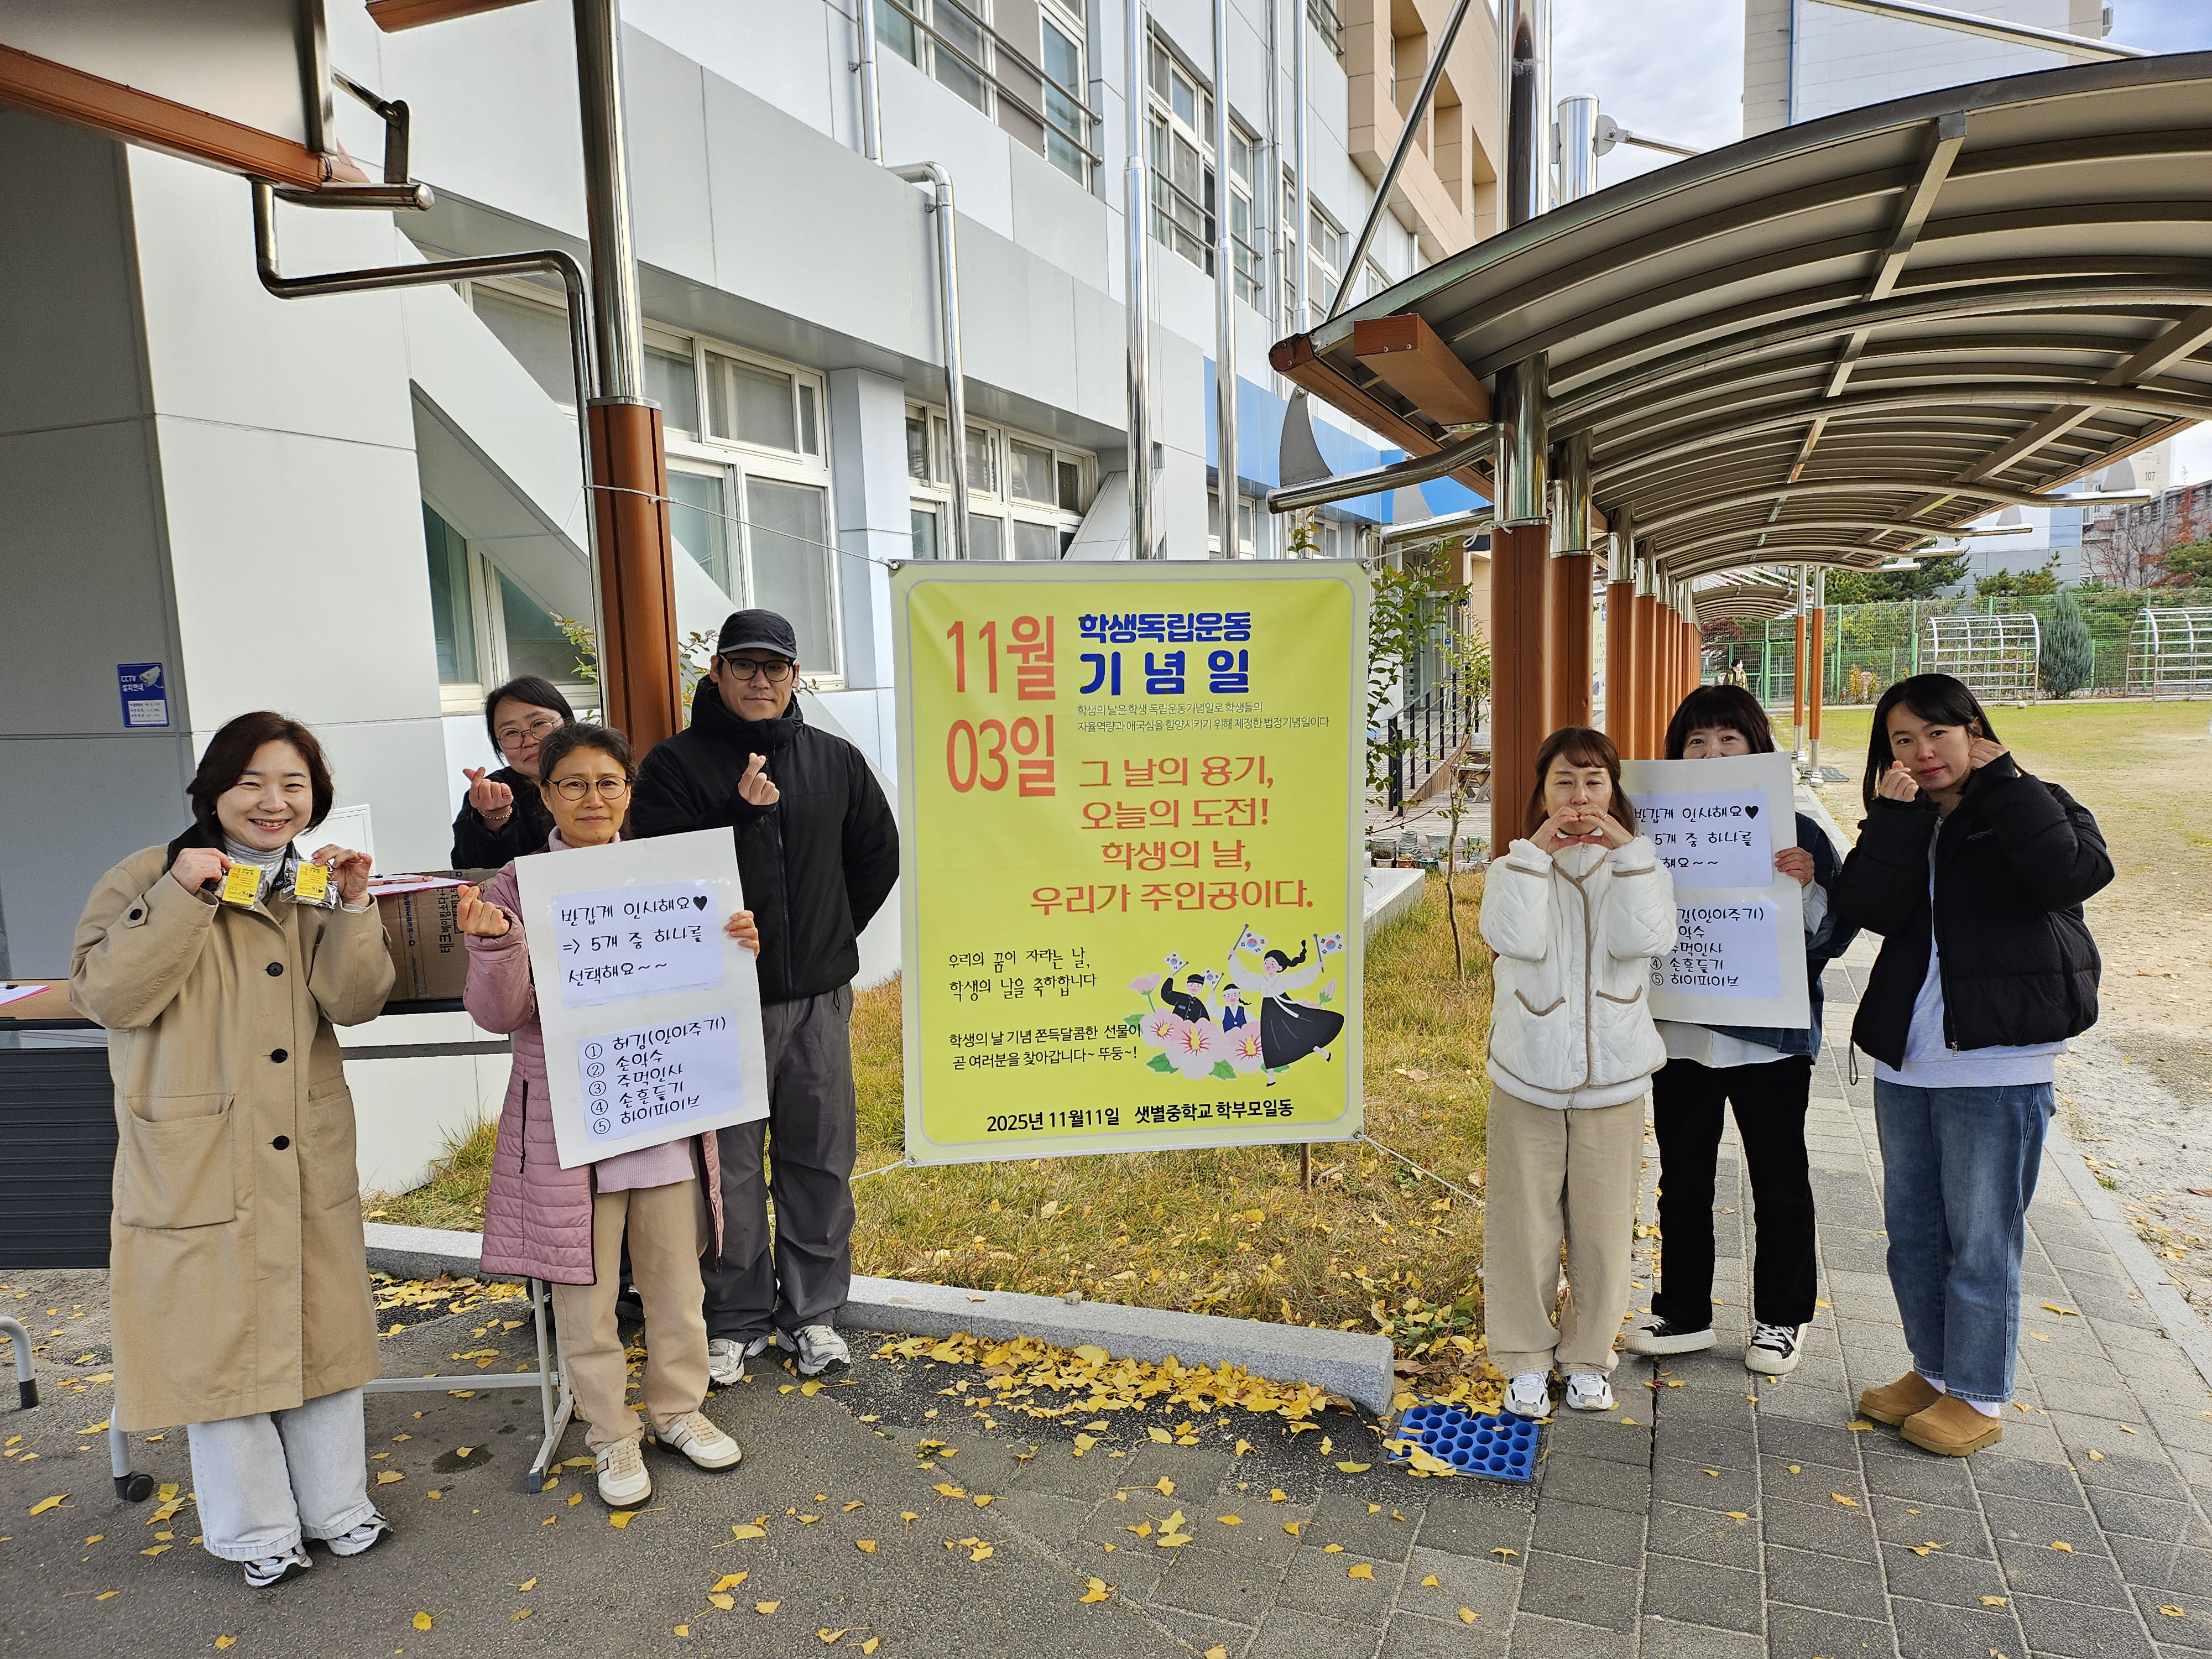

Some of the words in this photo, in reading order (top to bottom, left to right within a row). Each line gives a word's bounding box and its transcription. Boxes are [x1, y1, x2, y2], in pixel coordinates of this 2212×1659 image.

[2145, 472, 2156, 481] 107
[1078, 612, 1251, 643] 학생독립운동
[947, 616, 1055, 700] 11월
[1078, 705, 1105, 716] 학생의
[1108, 705, 1126, 715] 날은
[1129, 705, 1146, 715] 학생
[1149, 703, 1223, 714] 독립운동기념일로
[1225, 702, 1262, 713] 학생들의
[1078, 721, 1125, 732] 자율역량과
[1127, 720, 1164, 732] 애국심을
[1214, 718, 1232, 729] 위해
[1235, 718, 1262, 729] 제정한
[1264, 716, 1330, 728] 법정기념일이다
[947, 714, 1055, 797] 03일
[1079, 761, 1112, 787] 그
[1124, 758, 1187, 787] 날의
[1201, 756, 1273, 788] 용기,
[1081, 800, 1178, 829] 오늘의
[1192, 798, 1267, 826] 도전!
[1634, 808, 1673, 824] 반갑게
[1682, 806, 1741, 822] 인사해요
[1655, 833, 1676, 845] 5개
[1686, 833, 1697, 847] 중
[1708, 831, 1751, 846] 하나를
[1102, 841, 1199, 871] 학생의
[1213, 840, 1250, 872] 날,
[1031, 884, 1130, 915] 우리가
[1140, 880, 1313, 911] 주인공이다.
[562, 905, 613, 926] 반갑게
[624, 897, 689, 919] 인사해요
[592, 935, 617, 951] 5개
[629, 933, 642, 949] 중
[654, 926, 701, 942] 하나를
[949, 952, 983, 968] 우리의
[994, 951, 1015, 973] 꿈이
[1026, 949, 1063, 969] 자라는
[1072, 947, 1089, 968] 날,
[1670, 958, 1723, 973] 손흔들기
[950, 979, 990, 1002] 학생의
[1001, 978, 1024, 999] 날을
[1034, 973, 1097, 997] 축하합니다
[1671, 974, 1739, 987] 하이파이브
[949, 1032, 987, 1048] 학생의
[992, 1031, 1004, 1045] 날
[1008, 1030, 1031, 1044] 기념
[1035, 1026, 1098, 1043] 쫀득달콤한
[1104, 1023, 1140, 1039] 선물이
[616, 1050, 664, 1071] 손악수
[953, 1056, 966, 1070] 곧
[969, 1053, 1020, 1068] 여러분을
[1024, 1048, 1094, 1066] 찾아갑니다~
[1098, 1046, 1136, 1061] 뚜둥~!
[617, 1062, 682, 1087] 주먹인사
[619, 1081, 684, 1108] 손흔들기
[620, 1095, 699, 1124] 하이파이브
[987, 1112, 1043, 1131] 2025년
[1050, 1108, 1119, 1128] 11월11일
[1135, 1104, 1213, 1124] 샛별중학교
[1215, 1099, 1293, 1119] 학부모일동
